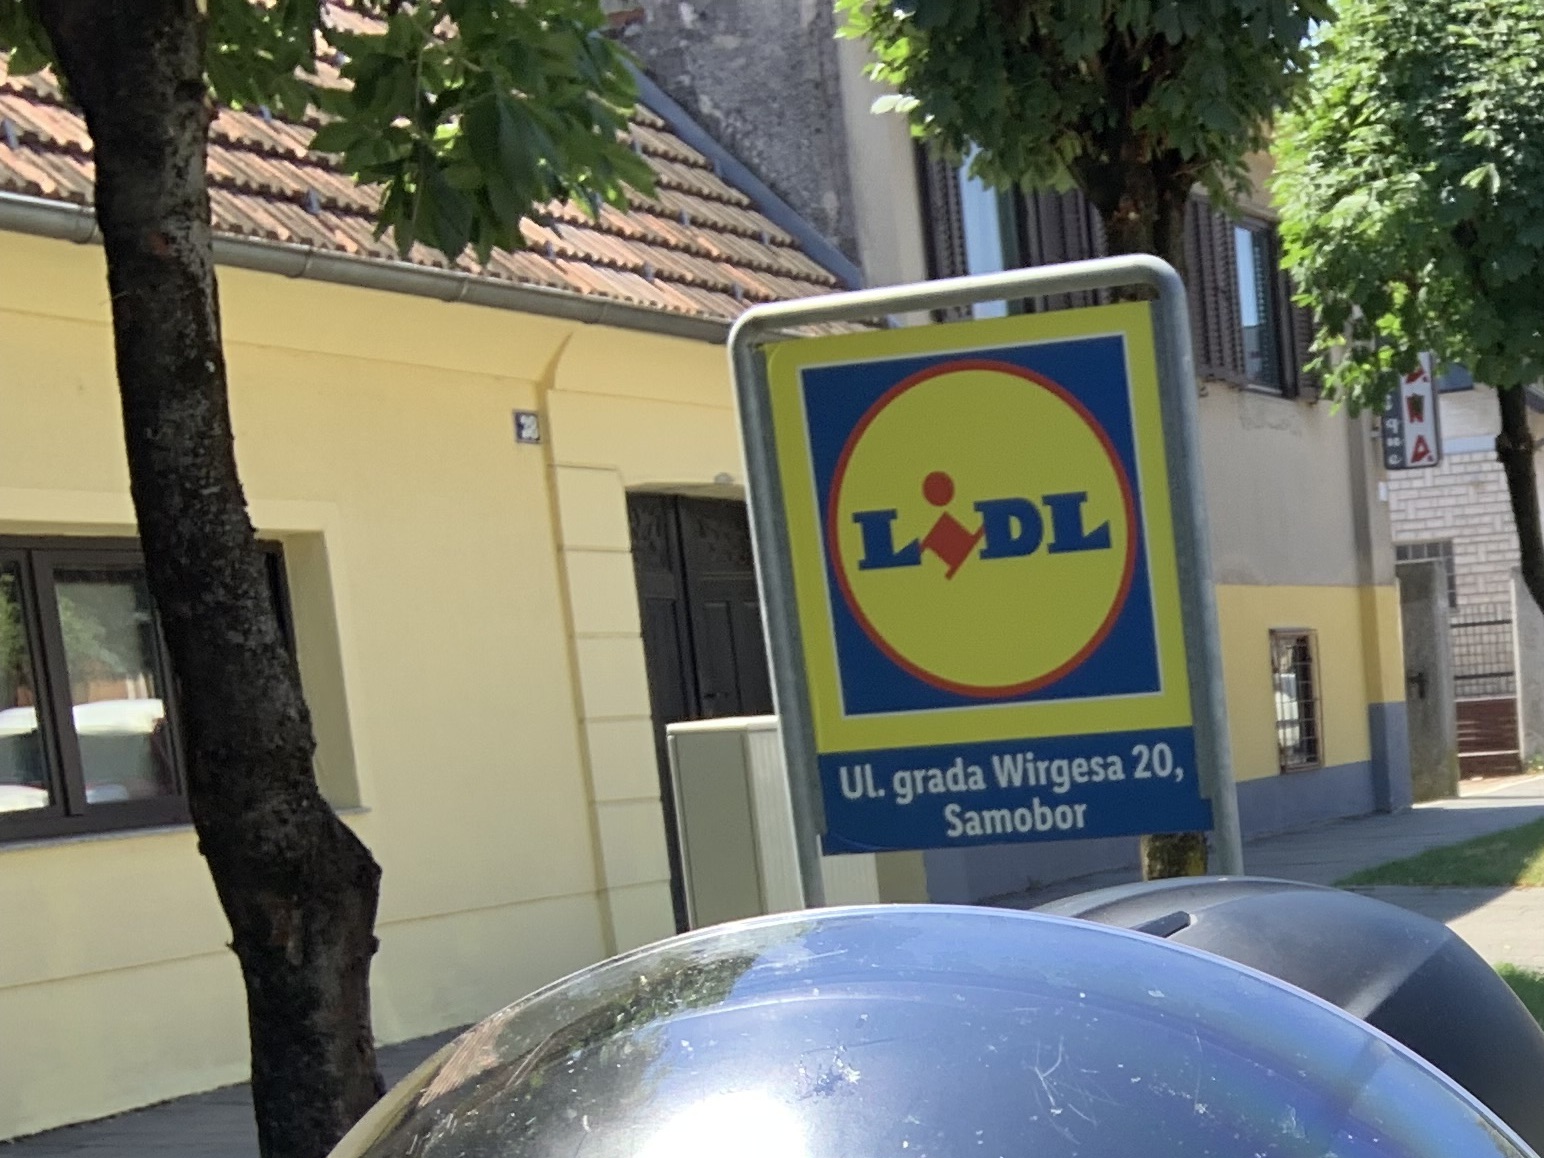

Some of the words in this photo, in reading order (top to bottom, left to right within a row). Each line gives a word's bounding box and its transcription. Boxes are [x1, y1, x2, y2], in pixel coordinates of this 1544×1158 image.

[839, 763, 885, 799] Ul.
[893, 757, 986, 805] grada
[992, 751, 1125, 794] Wirgesa
[1131, 742, 1184, 782] 20,
[944, 797, 1087, 837] Samobor
